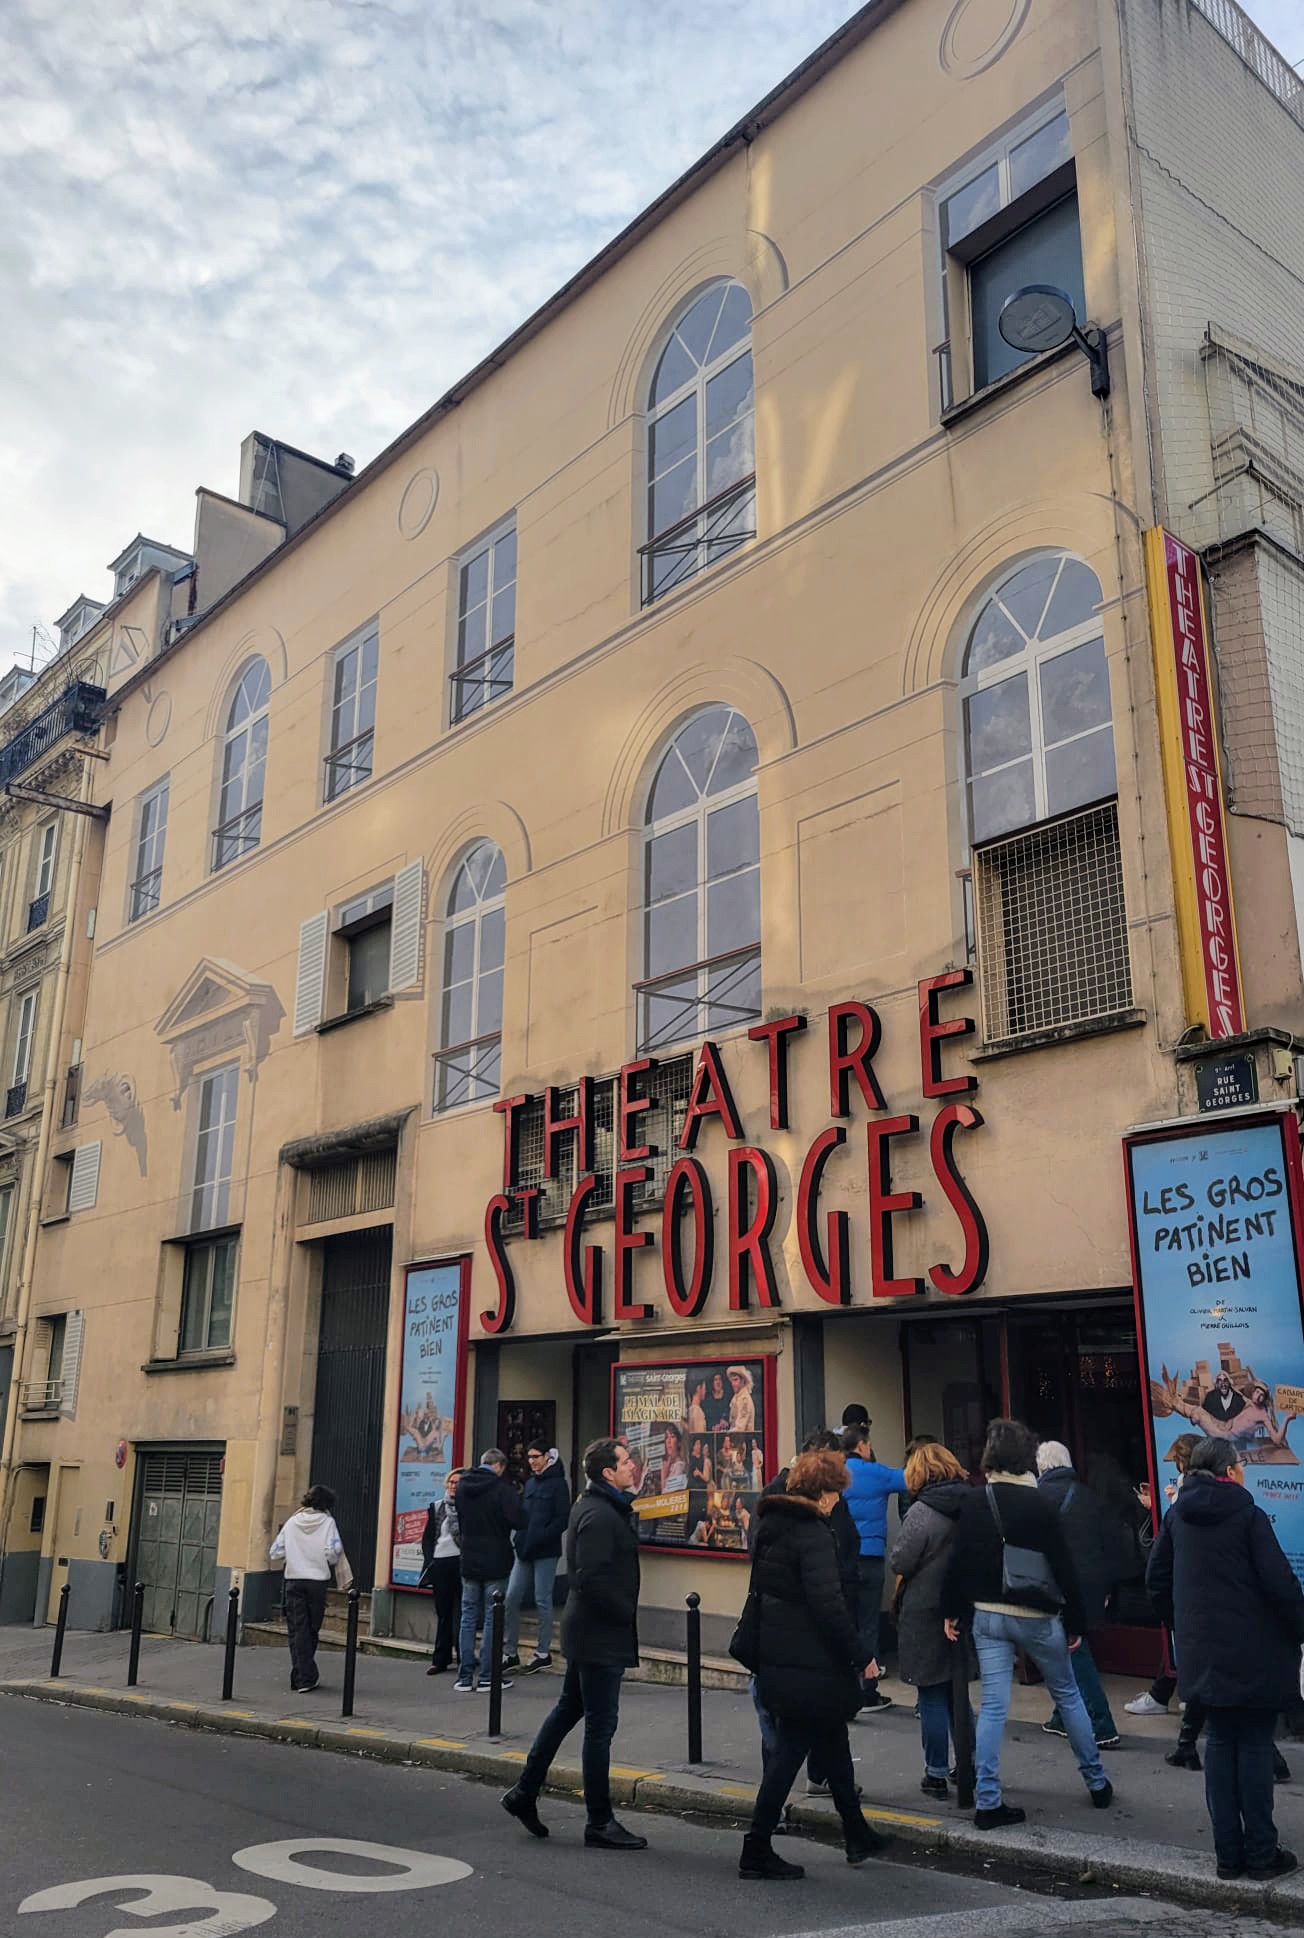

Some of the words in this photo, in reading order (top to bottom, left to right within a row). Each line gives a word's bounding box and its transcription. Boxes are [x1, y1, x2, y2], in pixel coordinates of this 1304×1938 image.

[1197, 801, 1234, 1039] GEORGES
[493, 969, 979, 1188] THEATRE
[1213, 1084, 1241, 1096] SAINT
[1217, 1075, 1235, 1086] RUE
[1205, 1092, 1251, 1107] GEORGES
[1143, 1183, 1196, 1215] LES
[1206, 1167, 1283, 1208] GROS
[563, 1103, 990, 1326] GEORGES
[408, 1295, 427, 1314] LES
[431, 1289, 458, 1312] GROS
[638, 1395, 679, 1408] MALADE
[623, 1408, 681, 1421] IMAGINAIRE
[17, 1837, 475, 1938] 30
